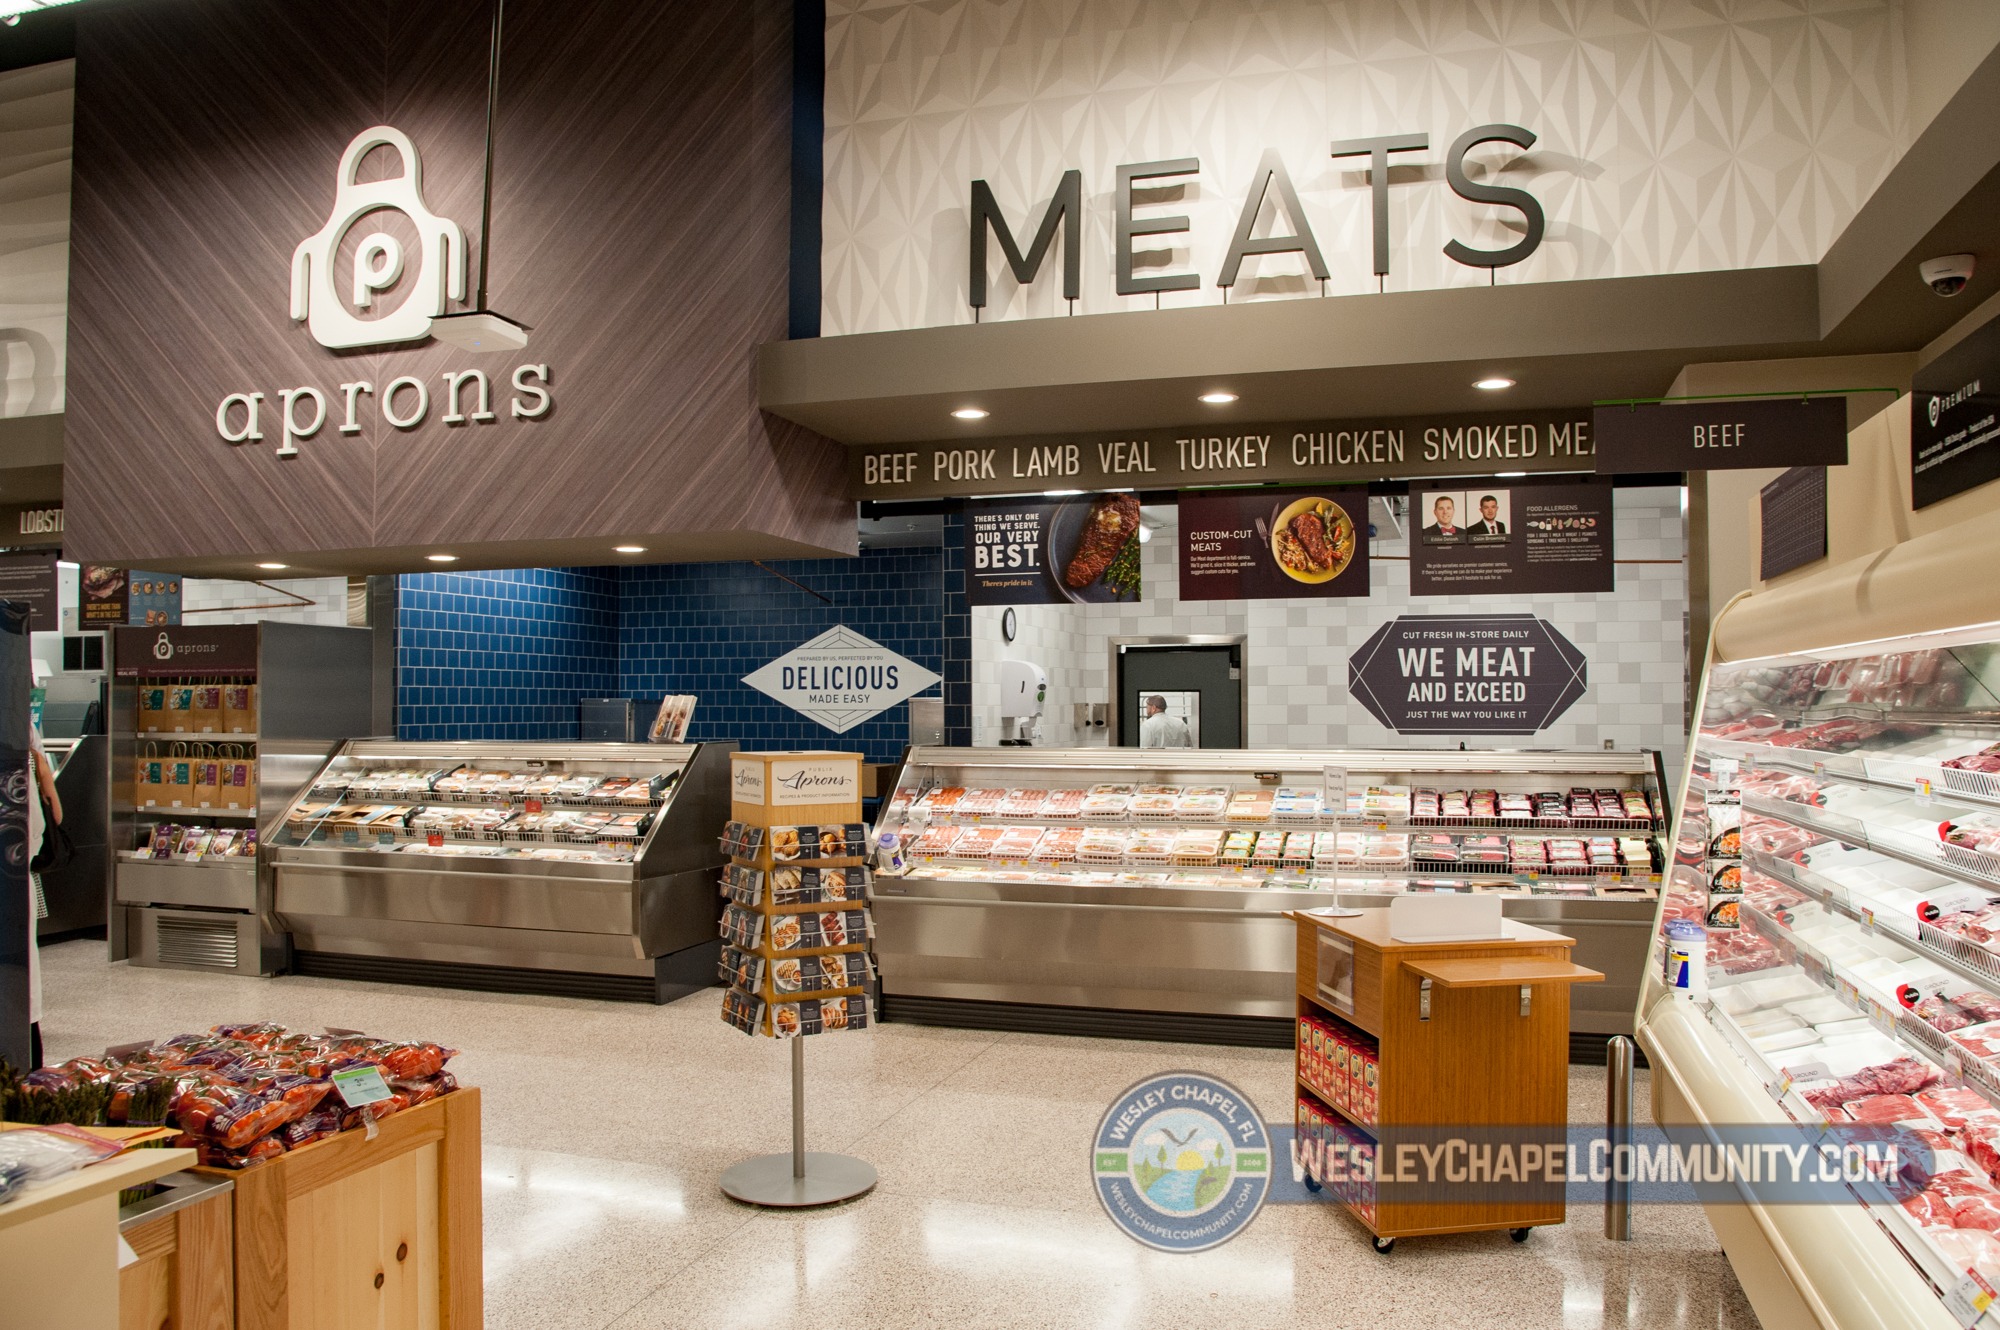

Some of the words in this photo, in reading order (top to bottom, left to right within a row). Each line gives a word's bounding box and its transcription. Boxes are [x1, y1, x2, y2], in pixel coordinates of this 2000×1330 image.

[970, 124, 1545, 308] MEATS
[1940, 380, 1981, 413] PREMIUM
[216, 364, 551, 456] aprons
[1693, 423, 1746, 448] BEEF
[865, 452, 918, 485] BEEF
[934, 449, 996, 481] PORK
[1012, 444, 1080, 478] LAMB
[1098, 441, 1156, 474] VEAL
[1176, 435, 1271, 471] TURKEY
[1292, 430, 1404, 466] CHICKEN
[1423, 424, 1538, 461] SMOKED
[1549, 422, 1595, 456] ME
[974, 514, 1003, 522] THERE'S
[1005, 514, 1022, 522] ONLY
[1000, 522, 1012, 530] WE
[1014, 522, 1040, 530] SERVE.
[975, 532, 1002, 544] OUR
[1007, 530, 1039, 542] VERY
[1190, 530, 1252, 540] CUSTOM-CUT
[974, 544, 1040, 568] BEST.
[1190, 542, 1222, 552] MEATS
[1004, 580, 1020, 588] pride
[177, 644, 216, 654] aprons
[1398, 648, 1444, 677] WE
[1456, 647, 1535, 677] MEAT
[782, 665, 898, 690] DELICIOUS
[809, 694, 838, 704] MADE
[844, 694, 870, 703] EASY
[1407, 682, 1446, 702] AND
[1454, 682, 1526, 702] EXCEED
[777, 770, 852, 790] Aprons
